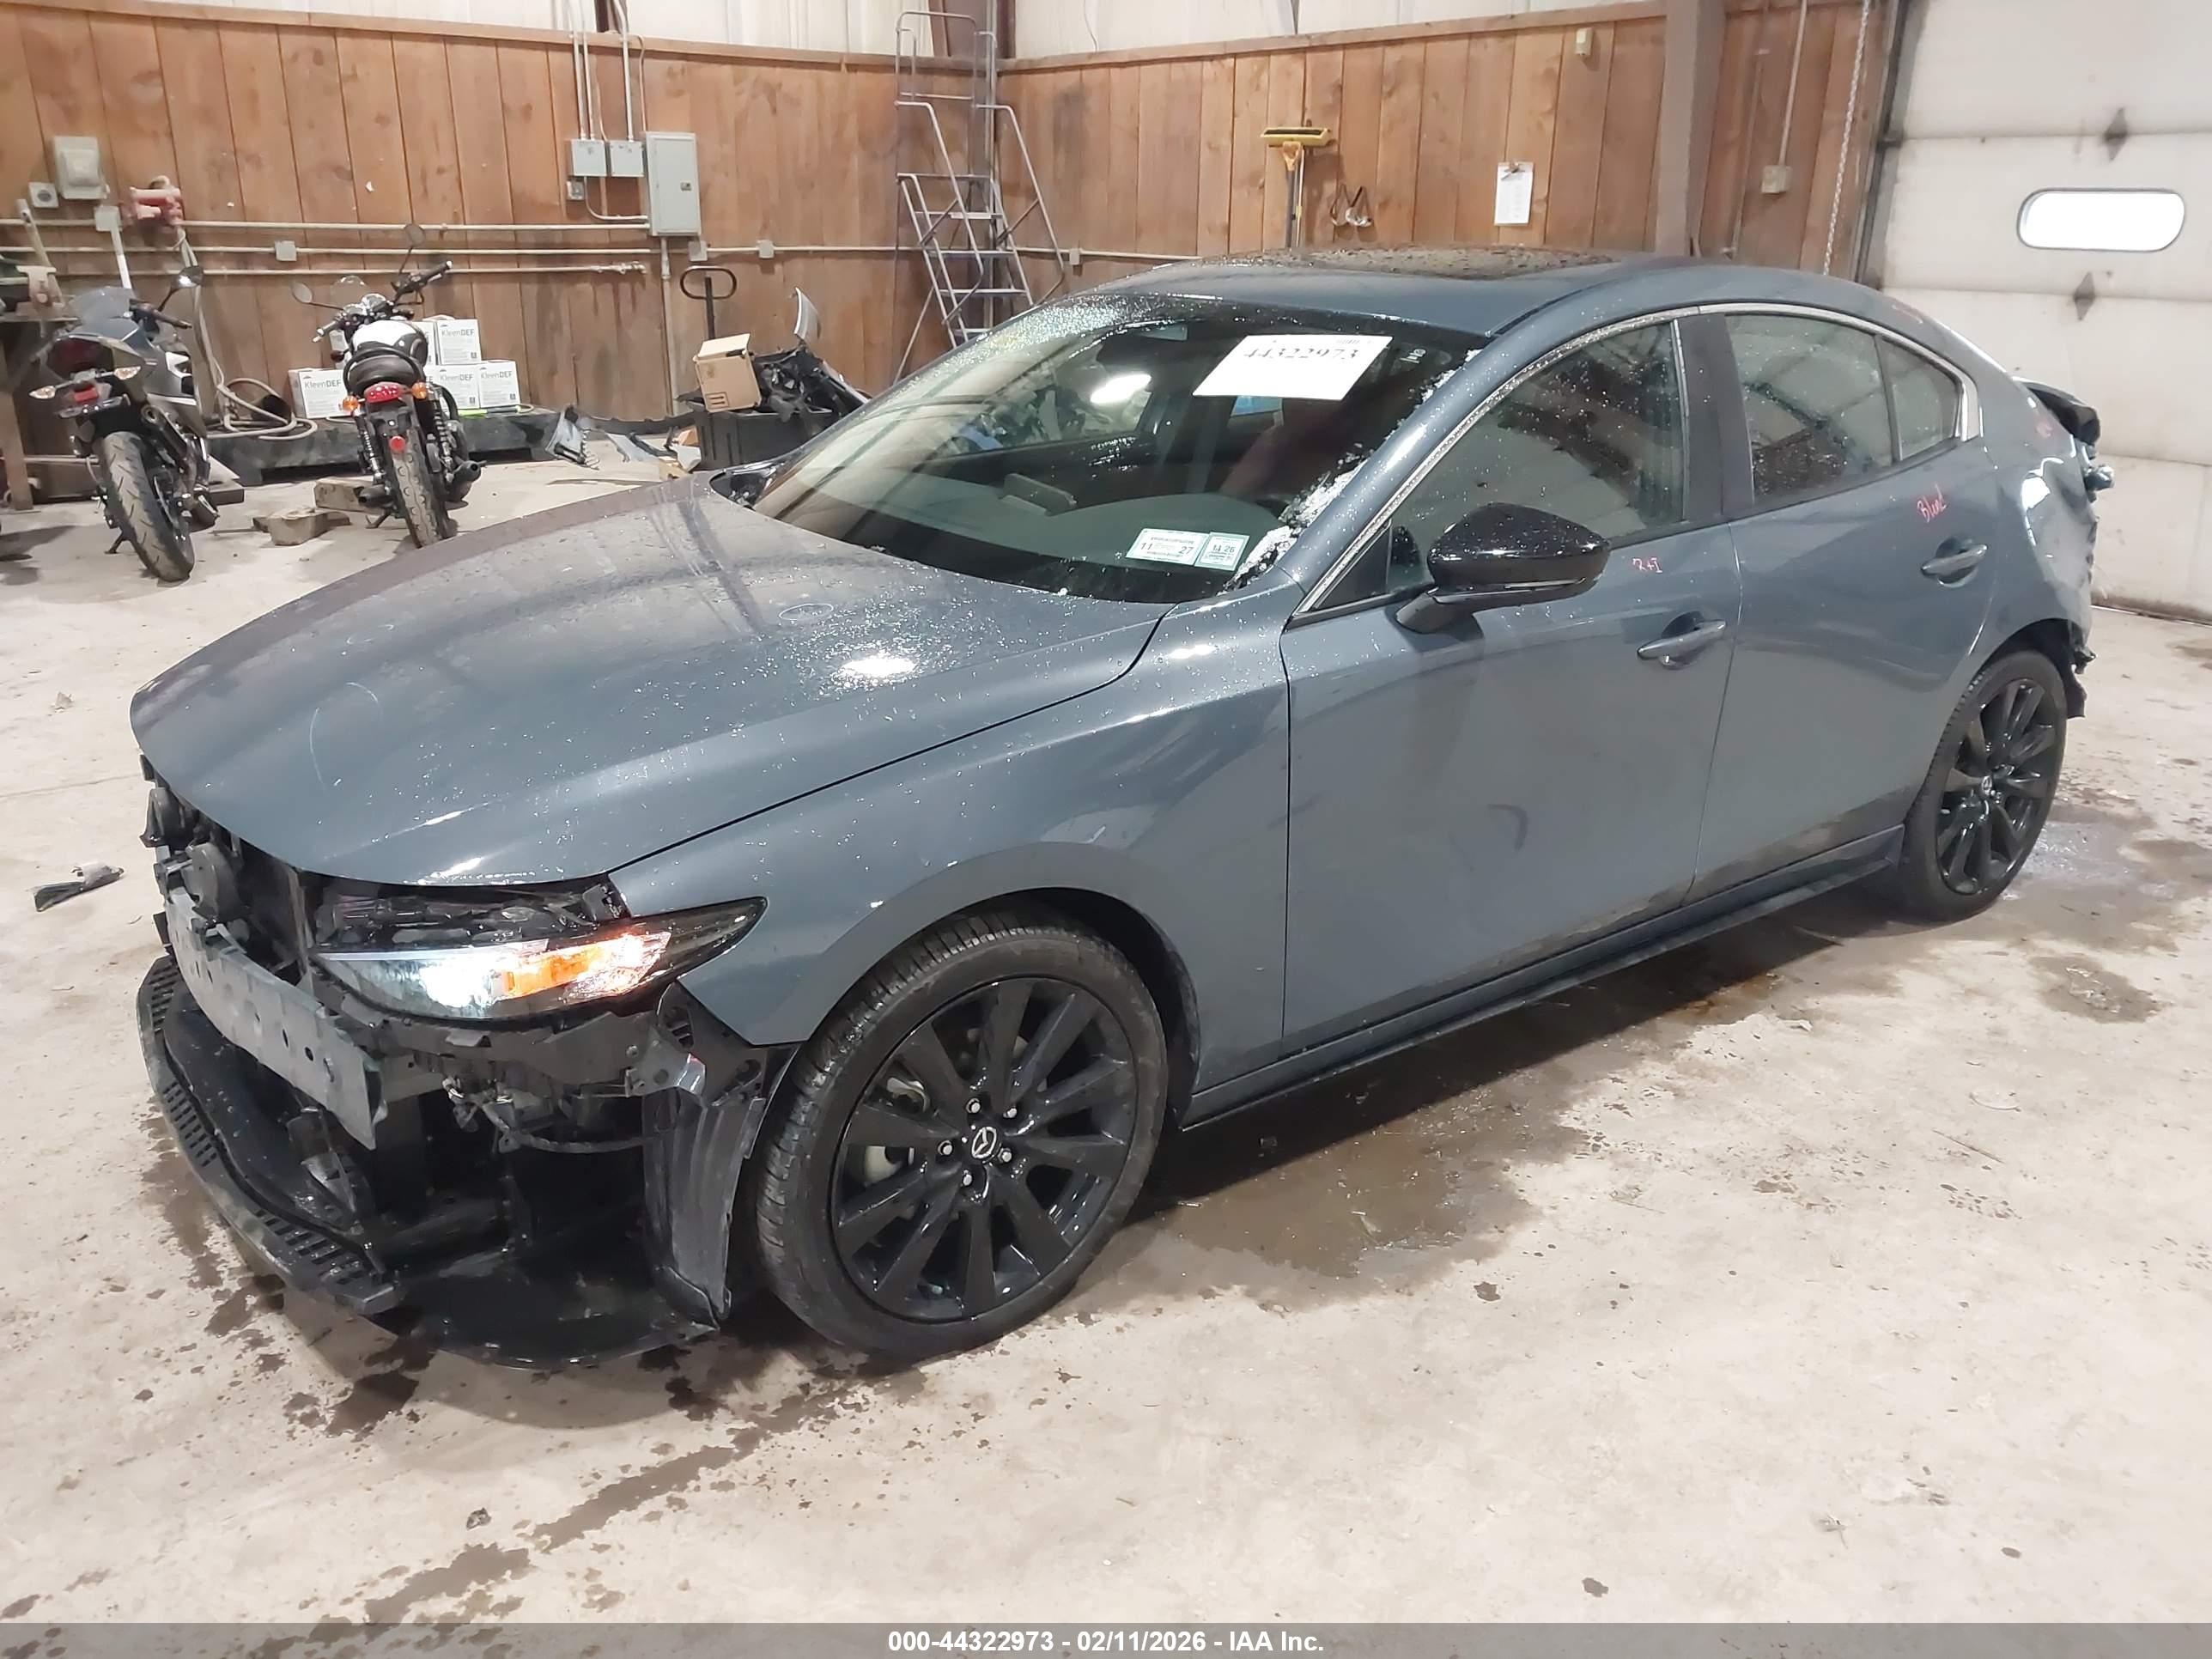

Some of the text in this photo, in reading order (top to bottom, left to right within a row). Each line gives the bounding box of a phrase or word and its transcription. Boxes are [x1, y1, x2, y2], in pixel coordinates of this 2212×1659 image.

[441, 328, 475, 337] KleenDEF
[304, 380, 342, 389] KleenDEF
[1178, 545, 1194, 556] 27
